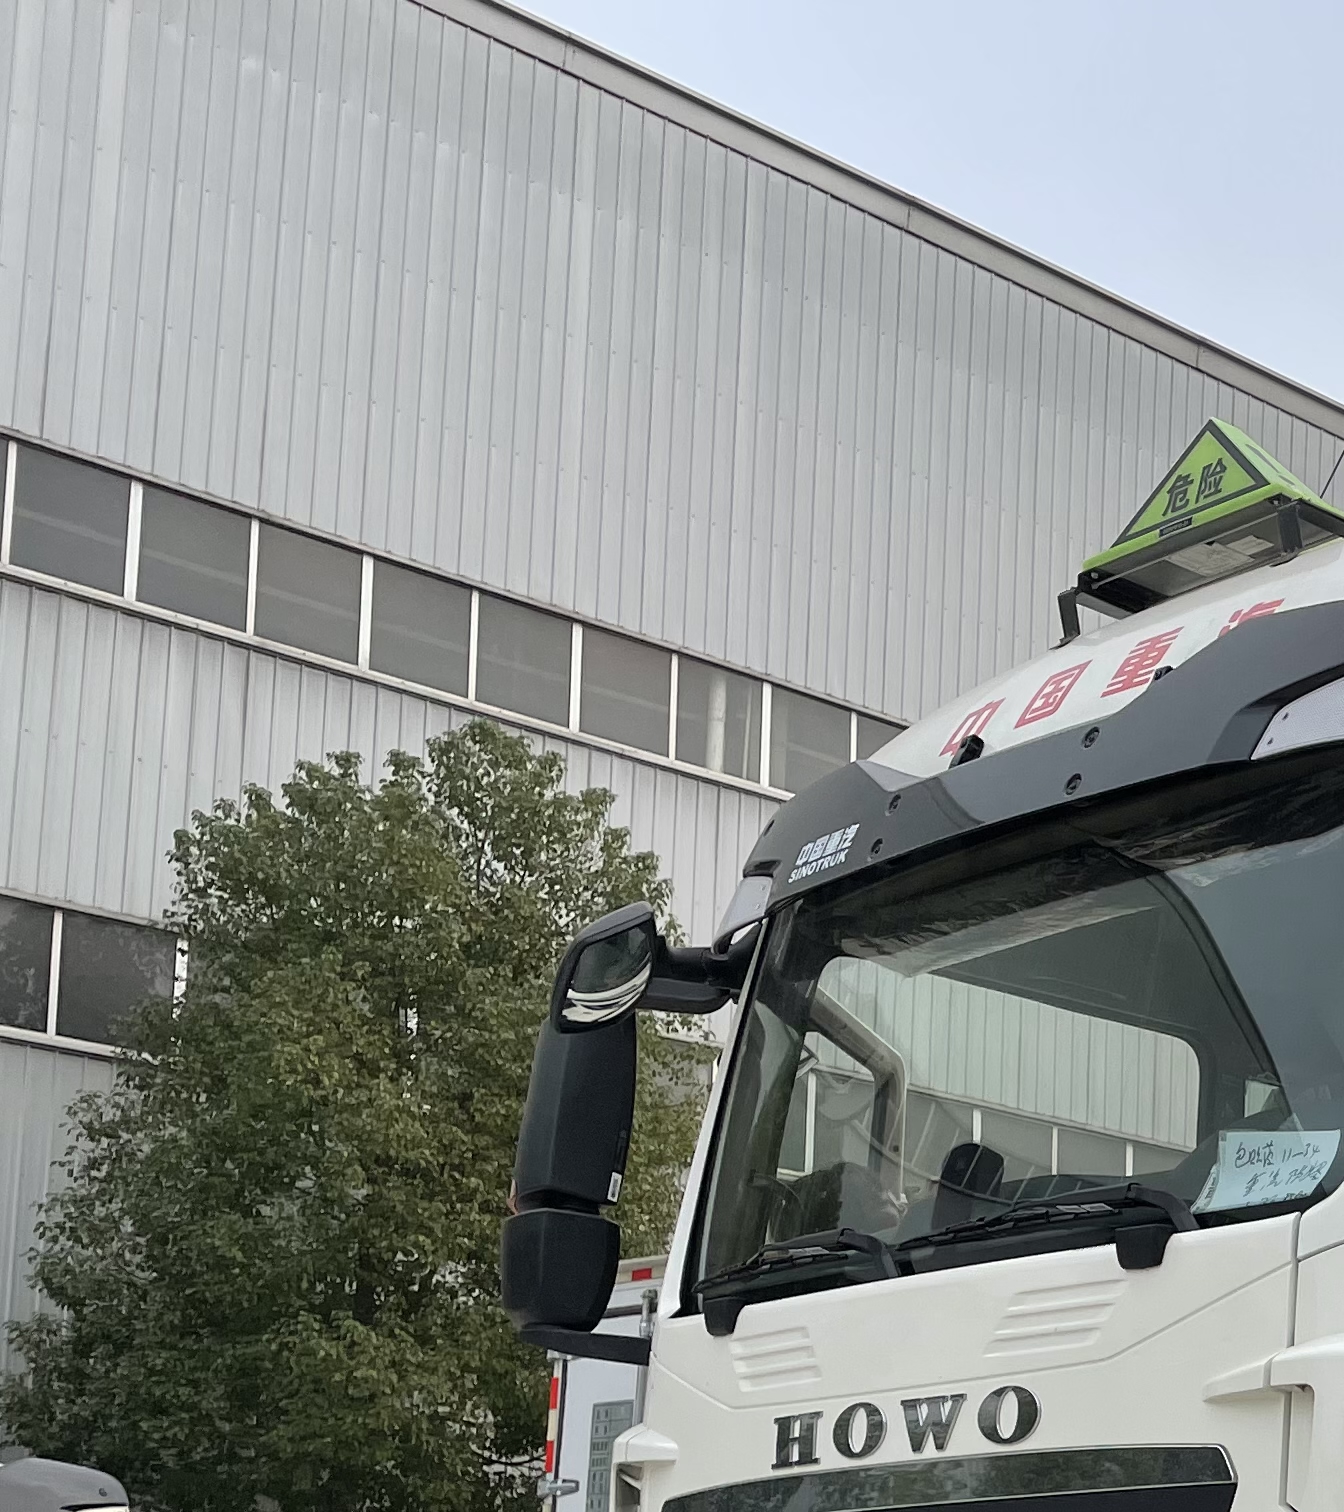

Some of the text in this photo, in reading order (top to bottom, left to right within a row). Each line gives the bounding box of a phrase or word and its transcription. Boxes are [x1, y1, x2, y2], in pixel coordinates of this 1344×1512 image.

[1162, 457, 1228, 516] 危险
[787, 848, 849, 884] SINOTRUK
[795, 823, 860, 866] 中国重汽
[770, 1384, 1043, 1471] HOWO
